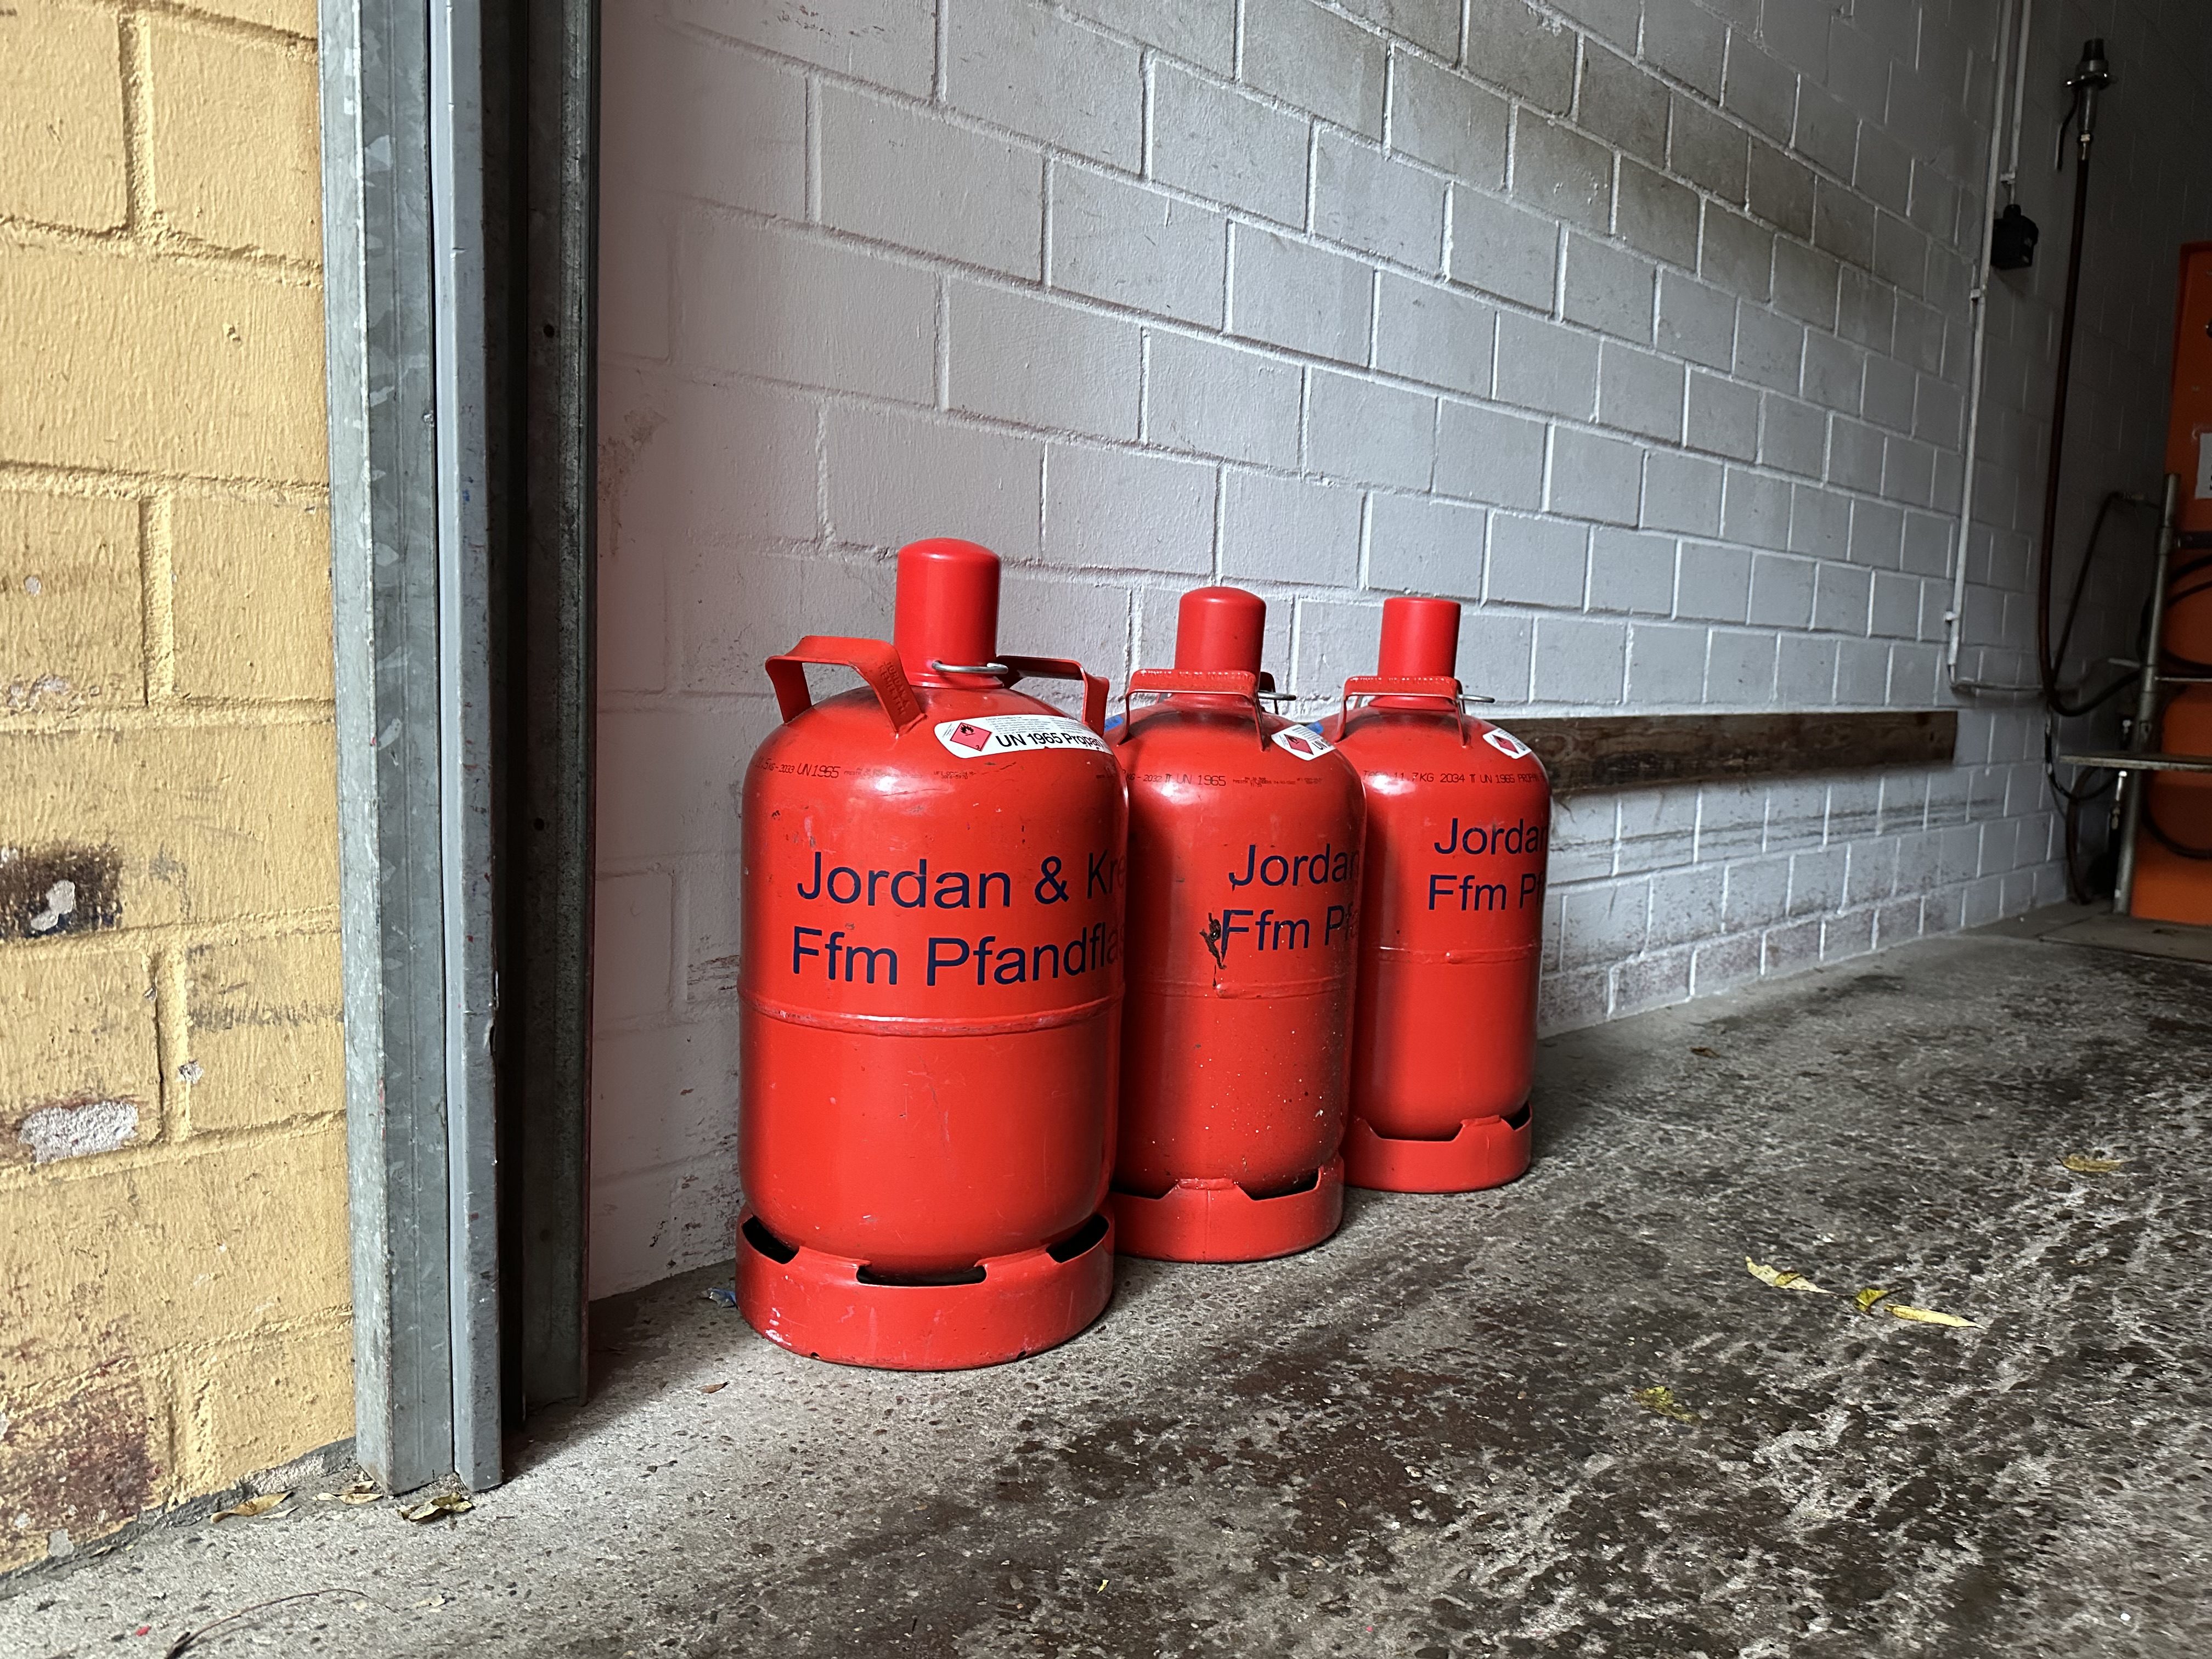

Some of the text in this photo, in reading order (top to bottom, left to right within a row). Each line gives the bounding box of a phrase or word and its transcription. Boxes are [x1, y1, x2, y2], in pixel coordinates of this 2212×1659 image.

[995, 732, 1104, 748] UN 1965 Propan
[1198, 775, 1226, 787] 1965
[1440, 773, 1465, 783] 2034
[1480, 774, 1493, 783] UN
[797, 851, 1011, 909] Jordan
[1034, 856, 1070, 905] &
[1228, 843, 1359, 887] Jordan
[1428, 874, 1506, 911] Ffm
[1221, 909, 1310, 958] Ffm
[793, 925, 898, 985] Ffm
